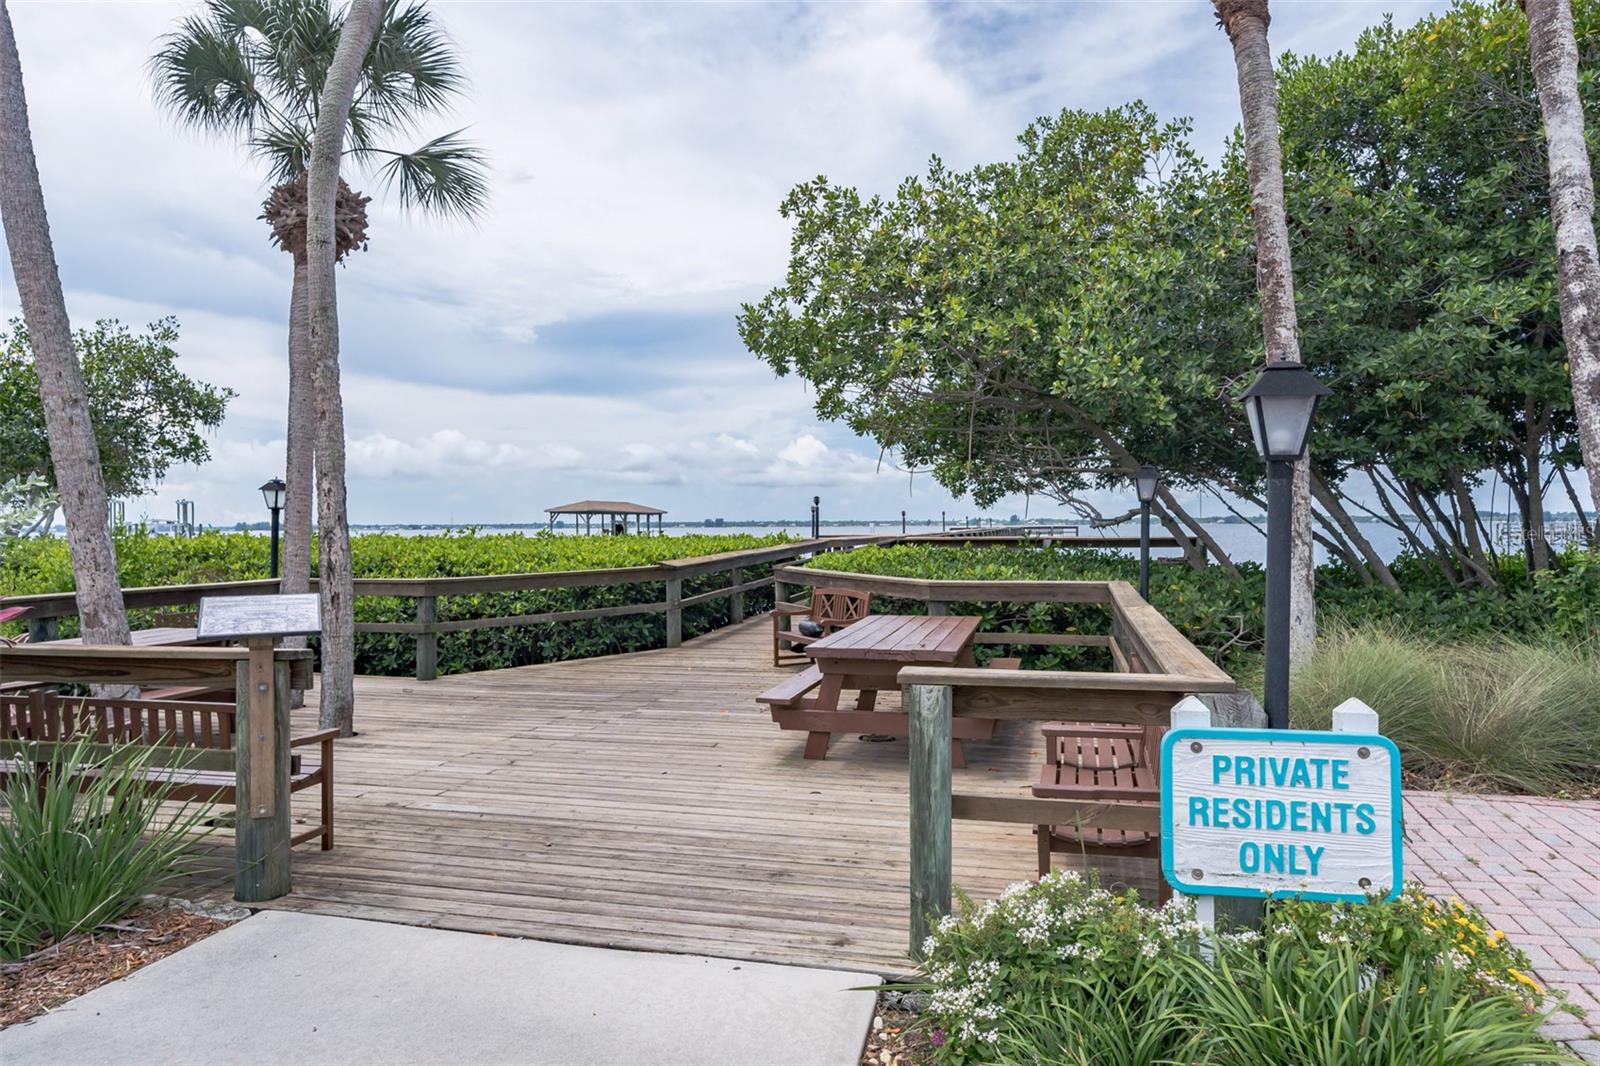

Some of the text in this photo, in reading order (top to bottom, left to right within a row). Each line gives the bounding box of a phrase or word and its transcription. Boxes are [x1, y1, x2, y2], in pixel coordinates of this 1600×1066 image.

[1212, 754, 1350, 790] PRIVATE
[1188, 796, 1377, 835] RESIDENTS
[1239, 841, 1325, 876] ONLY
